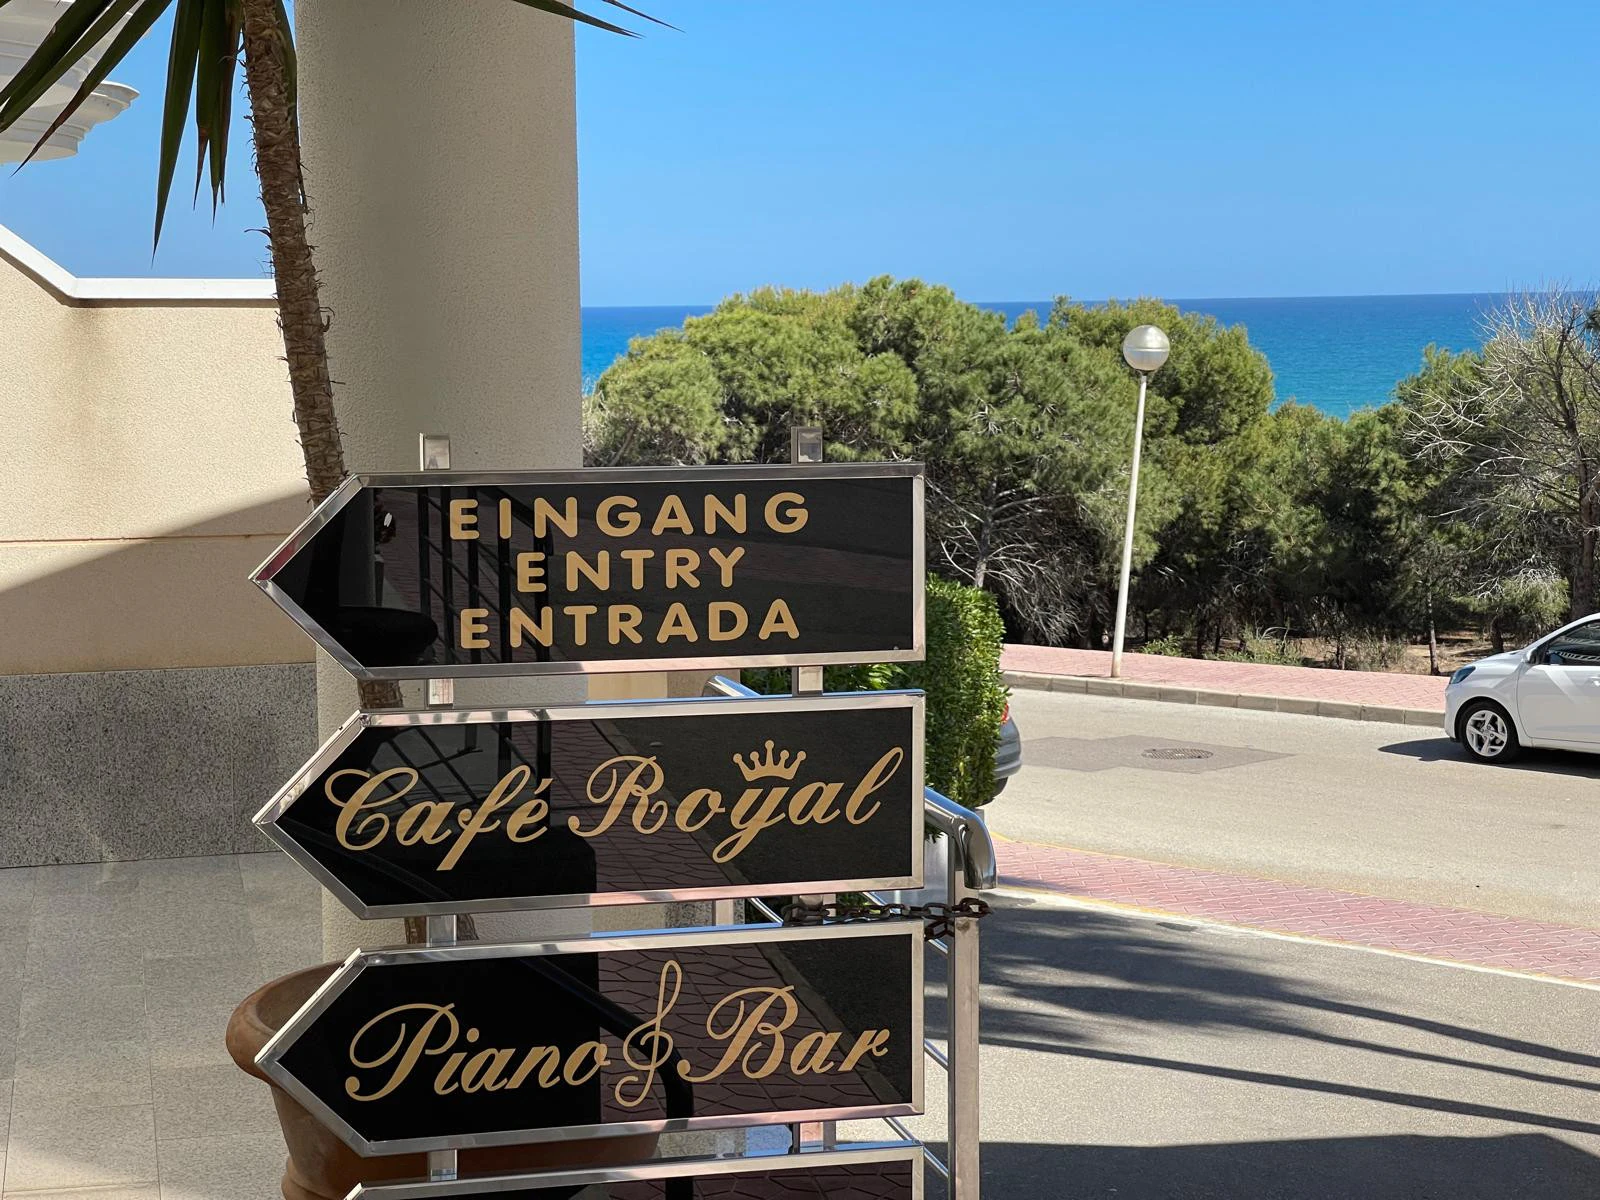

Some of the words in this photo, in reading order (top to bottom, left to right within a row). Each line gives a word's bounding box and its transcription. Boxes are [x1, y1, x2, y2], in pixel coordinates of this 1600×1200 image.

[449, 492, 809, 540] EINGANG
[516, 547, 745, 593] ENTRY
[460, 599, 799, 649] ENTRADA
[324, 764, 552, 871] Café
[567, 746, 904, 864] Royal
[345, 1002, 611, 1102] Piano
[678, 985, 890, 1083] Bar
